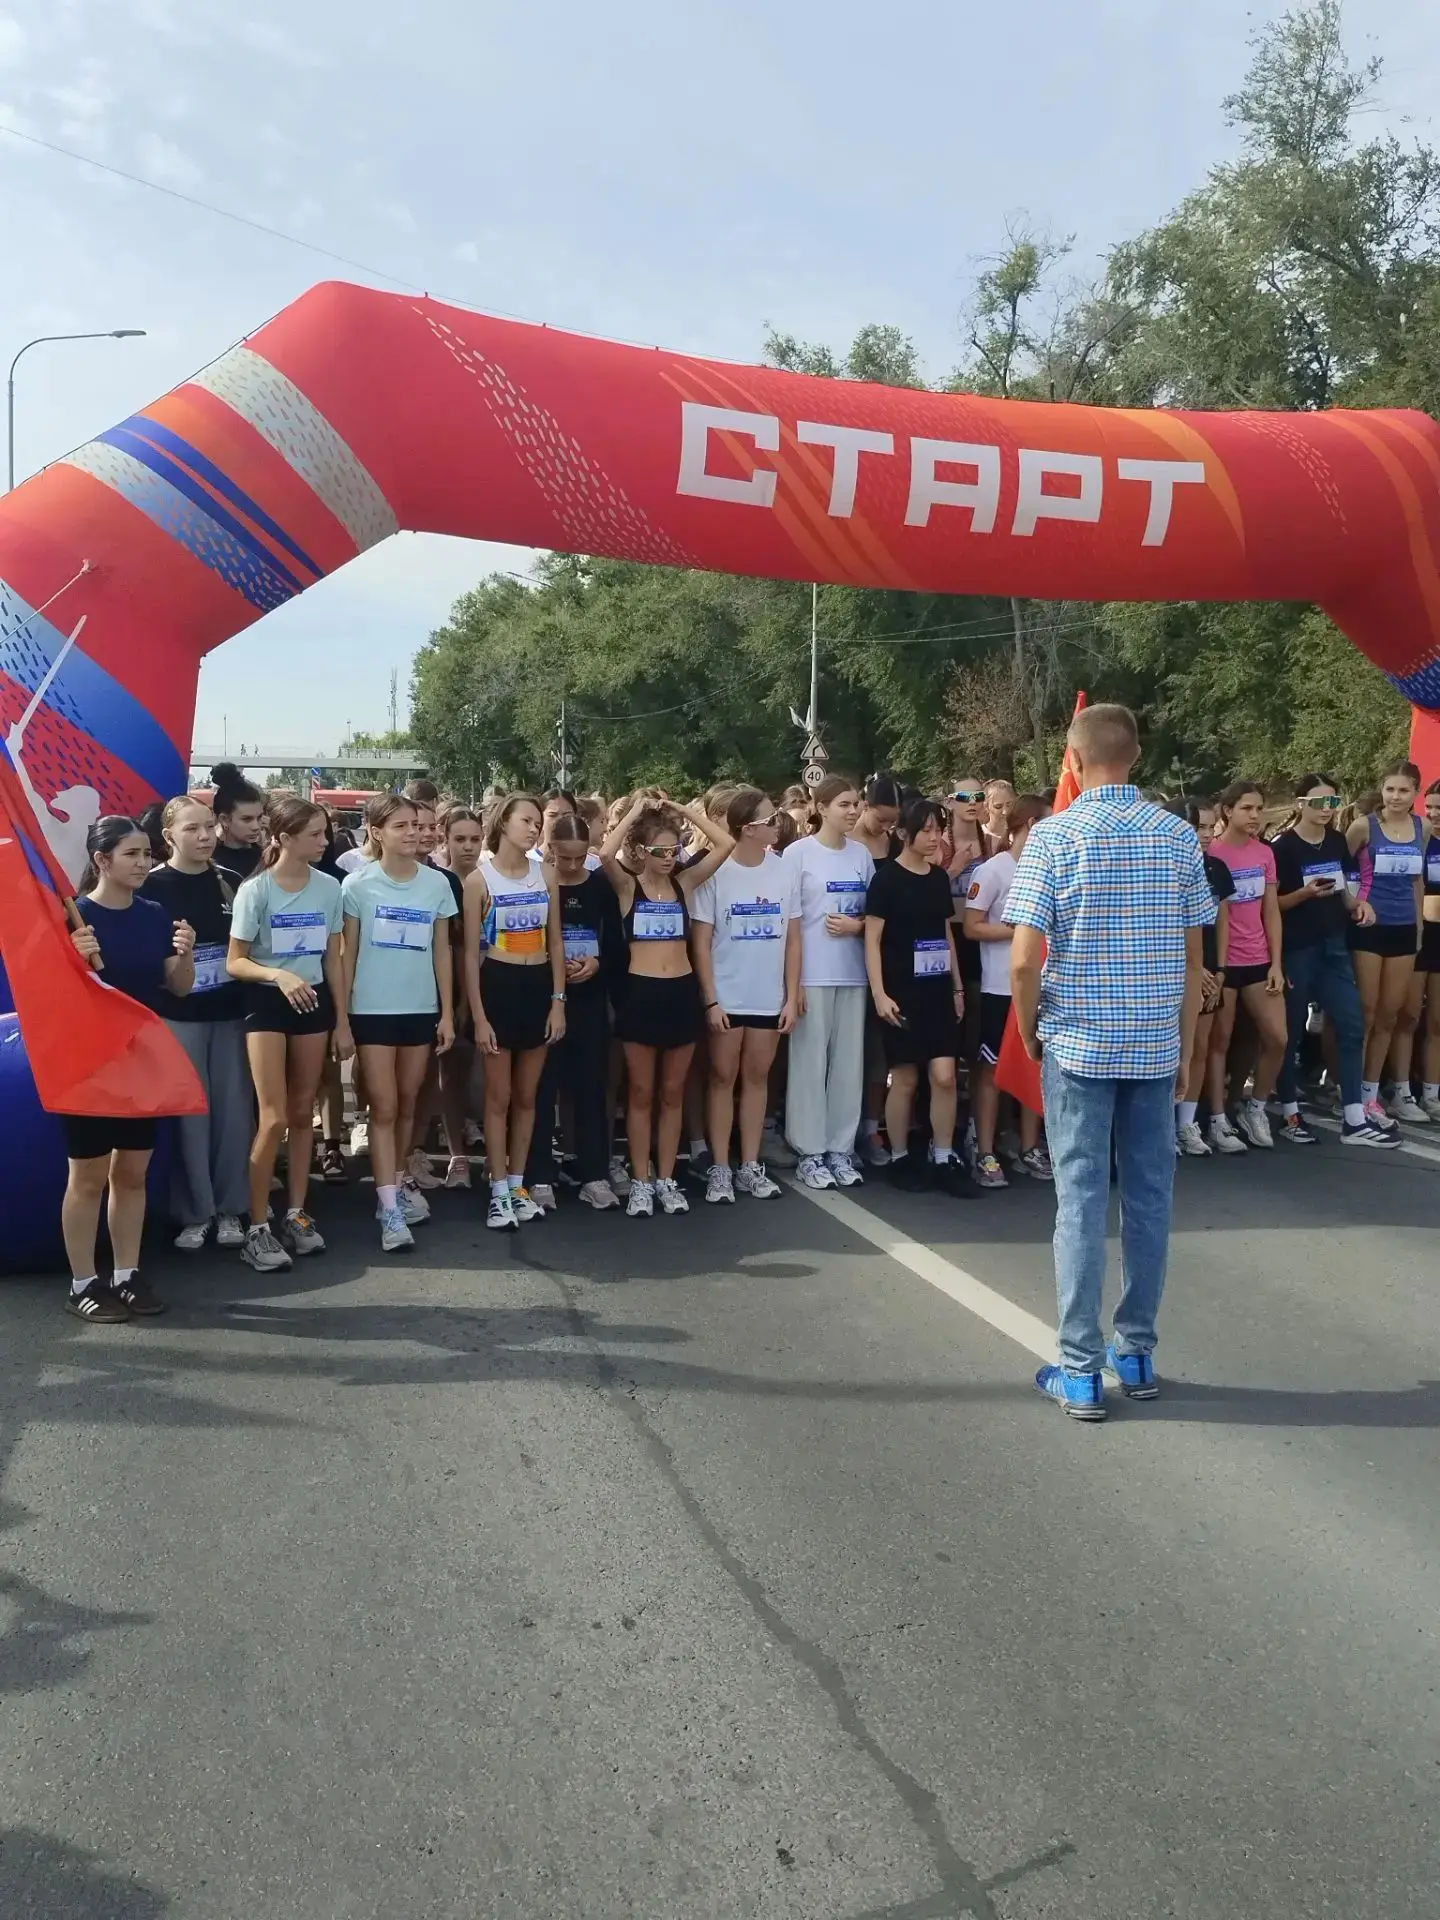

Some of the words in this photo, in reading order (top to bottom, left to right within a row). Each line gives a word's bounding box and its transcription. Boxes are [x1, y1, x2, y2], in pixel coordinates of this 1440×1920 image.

[676, 401, 1206, 547] СТАРТ
[807, 771, 822, 782] 40
[504, 908, 541, 928] 666
[641, 918, 677, 935] 133
[740, 918, 774, 935] 136
[293, 932, 307, 951] 2
[397, 926, 406, 944] 1
